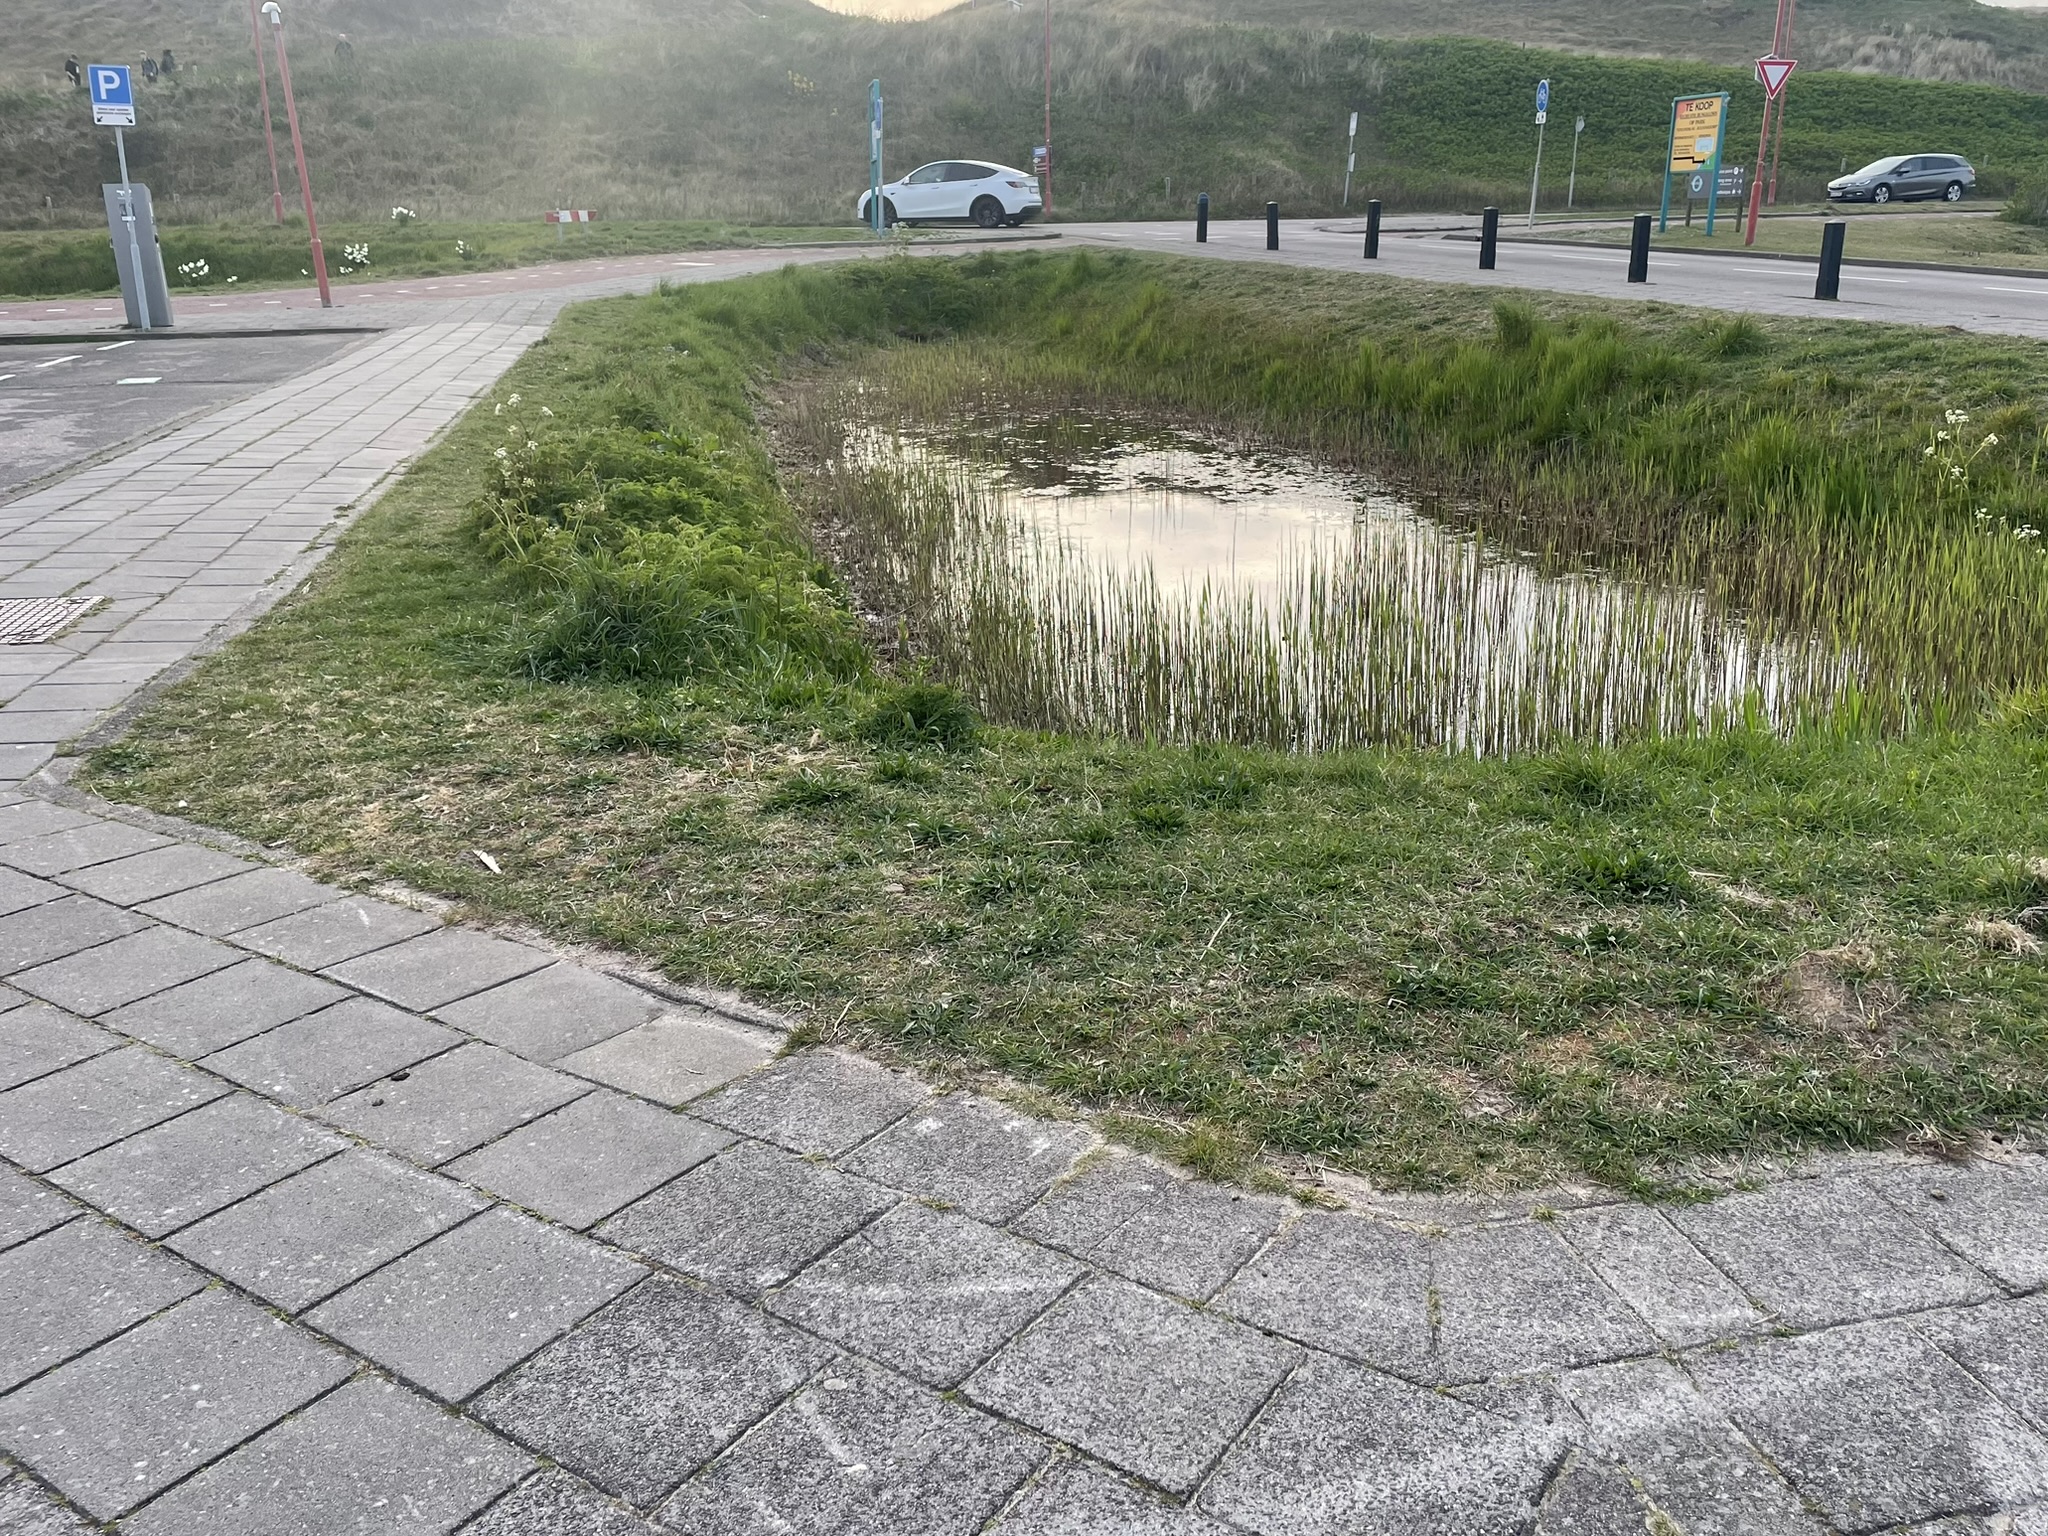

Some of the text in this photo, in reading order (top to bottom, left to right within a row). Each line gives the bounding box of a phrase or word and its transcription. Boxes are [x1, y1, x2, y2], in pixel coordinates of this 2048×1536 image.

[97, 69, 121, 100] P
[1686, 100, 1714, 112] TE KOOP
